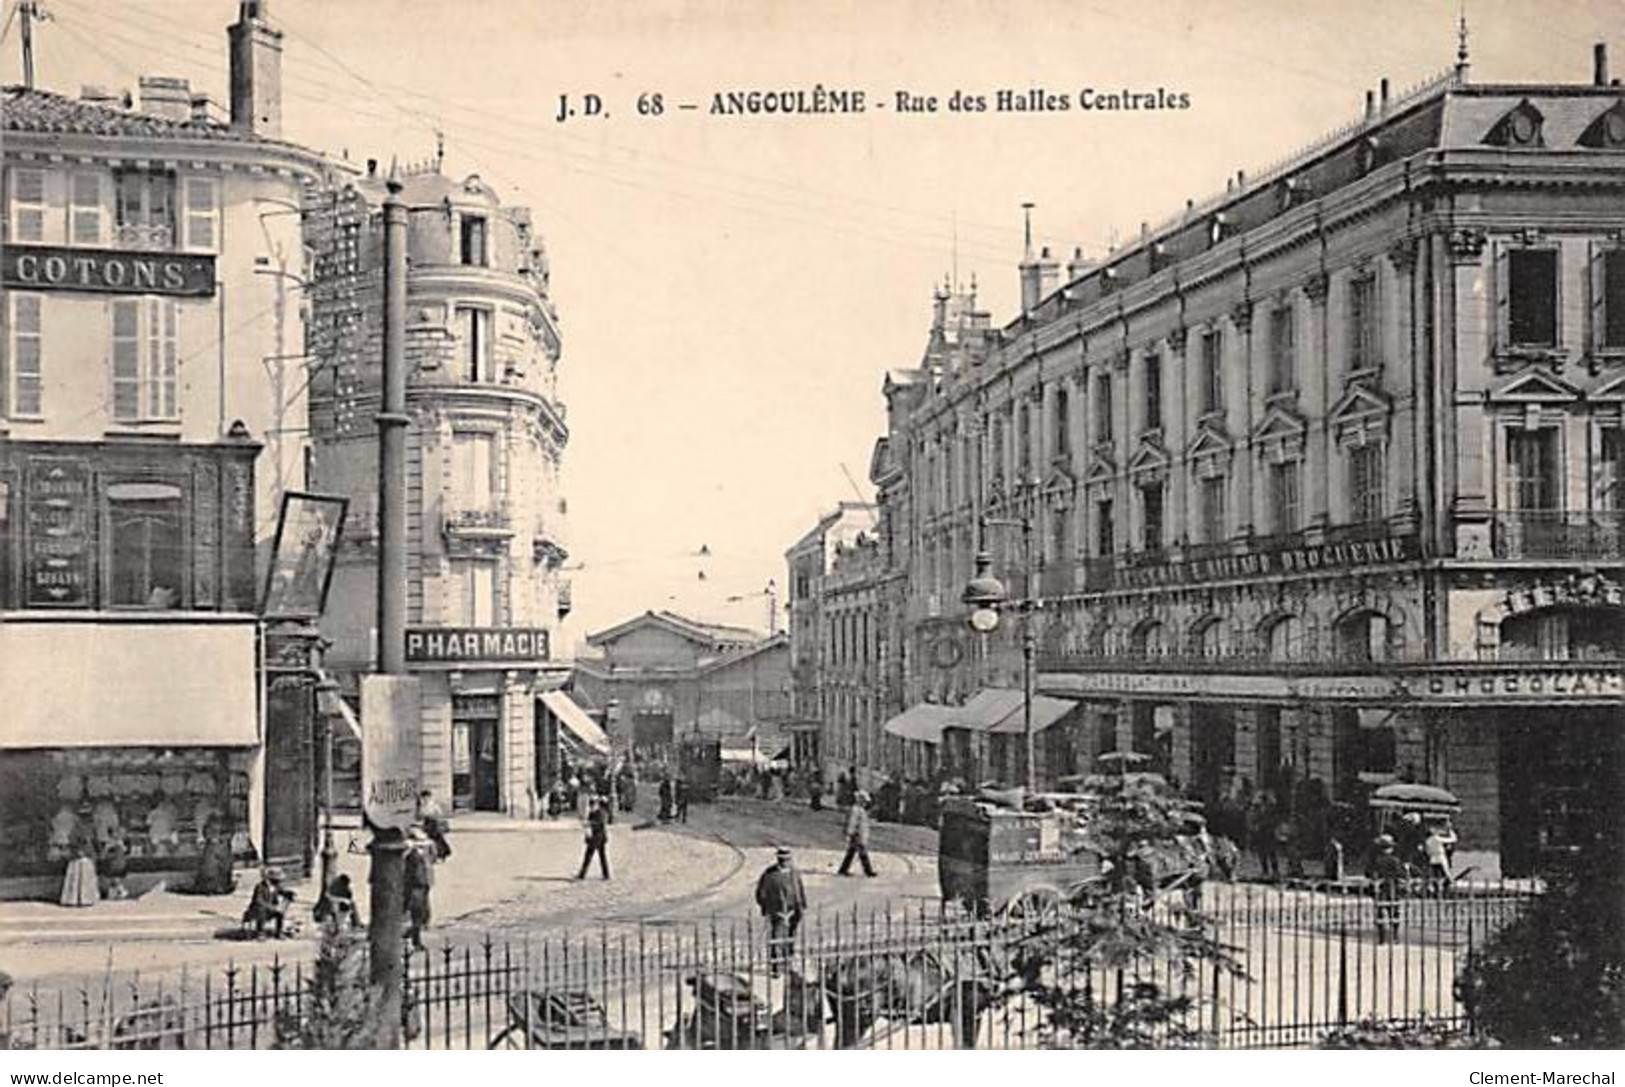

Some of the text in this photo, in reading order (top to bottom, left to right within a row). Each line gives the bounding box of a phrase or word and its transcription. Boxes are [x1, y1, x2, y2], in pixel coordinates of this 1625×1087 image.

[16, 255, 185, 289] COTONS
[1281, 539, 1406, 571] DROGUERIE
[408, 632, 546, 657] PHARMACIE
